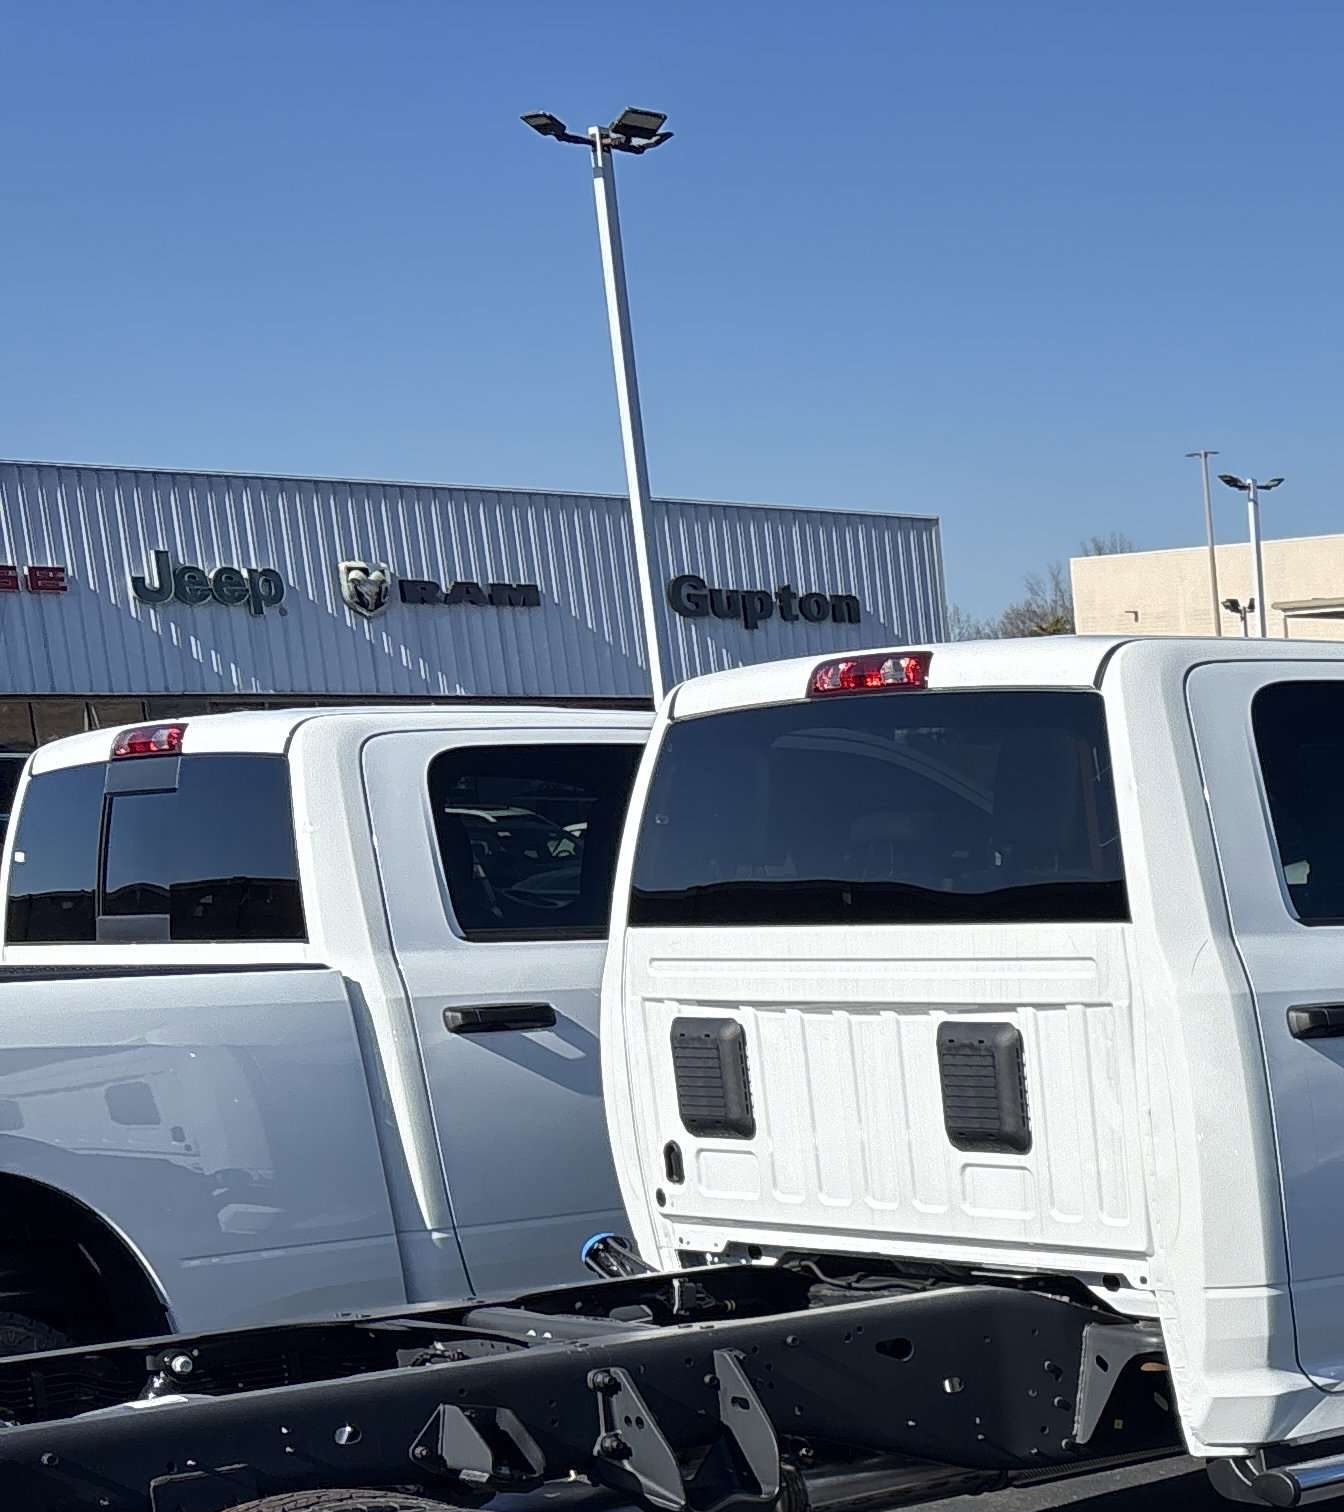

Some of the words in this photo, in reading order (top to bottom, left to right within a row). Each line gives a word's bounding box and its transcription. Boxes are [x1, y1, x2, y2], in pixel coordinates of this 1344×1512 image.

[131, 549, 286, 616] Jeep
[398, 579, 541, 607] RAM
[667, 574, 861, 630] Gupton
